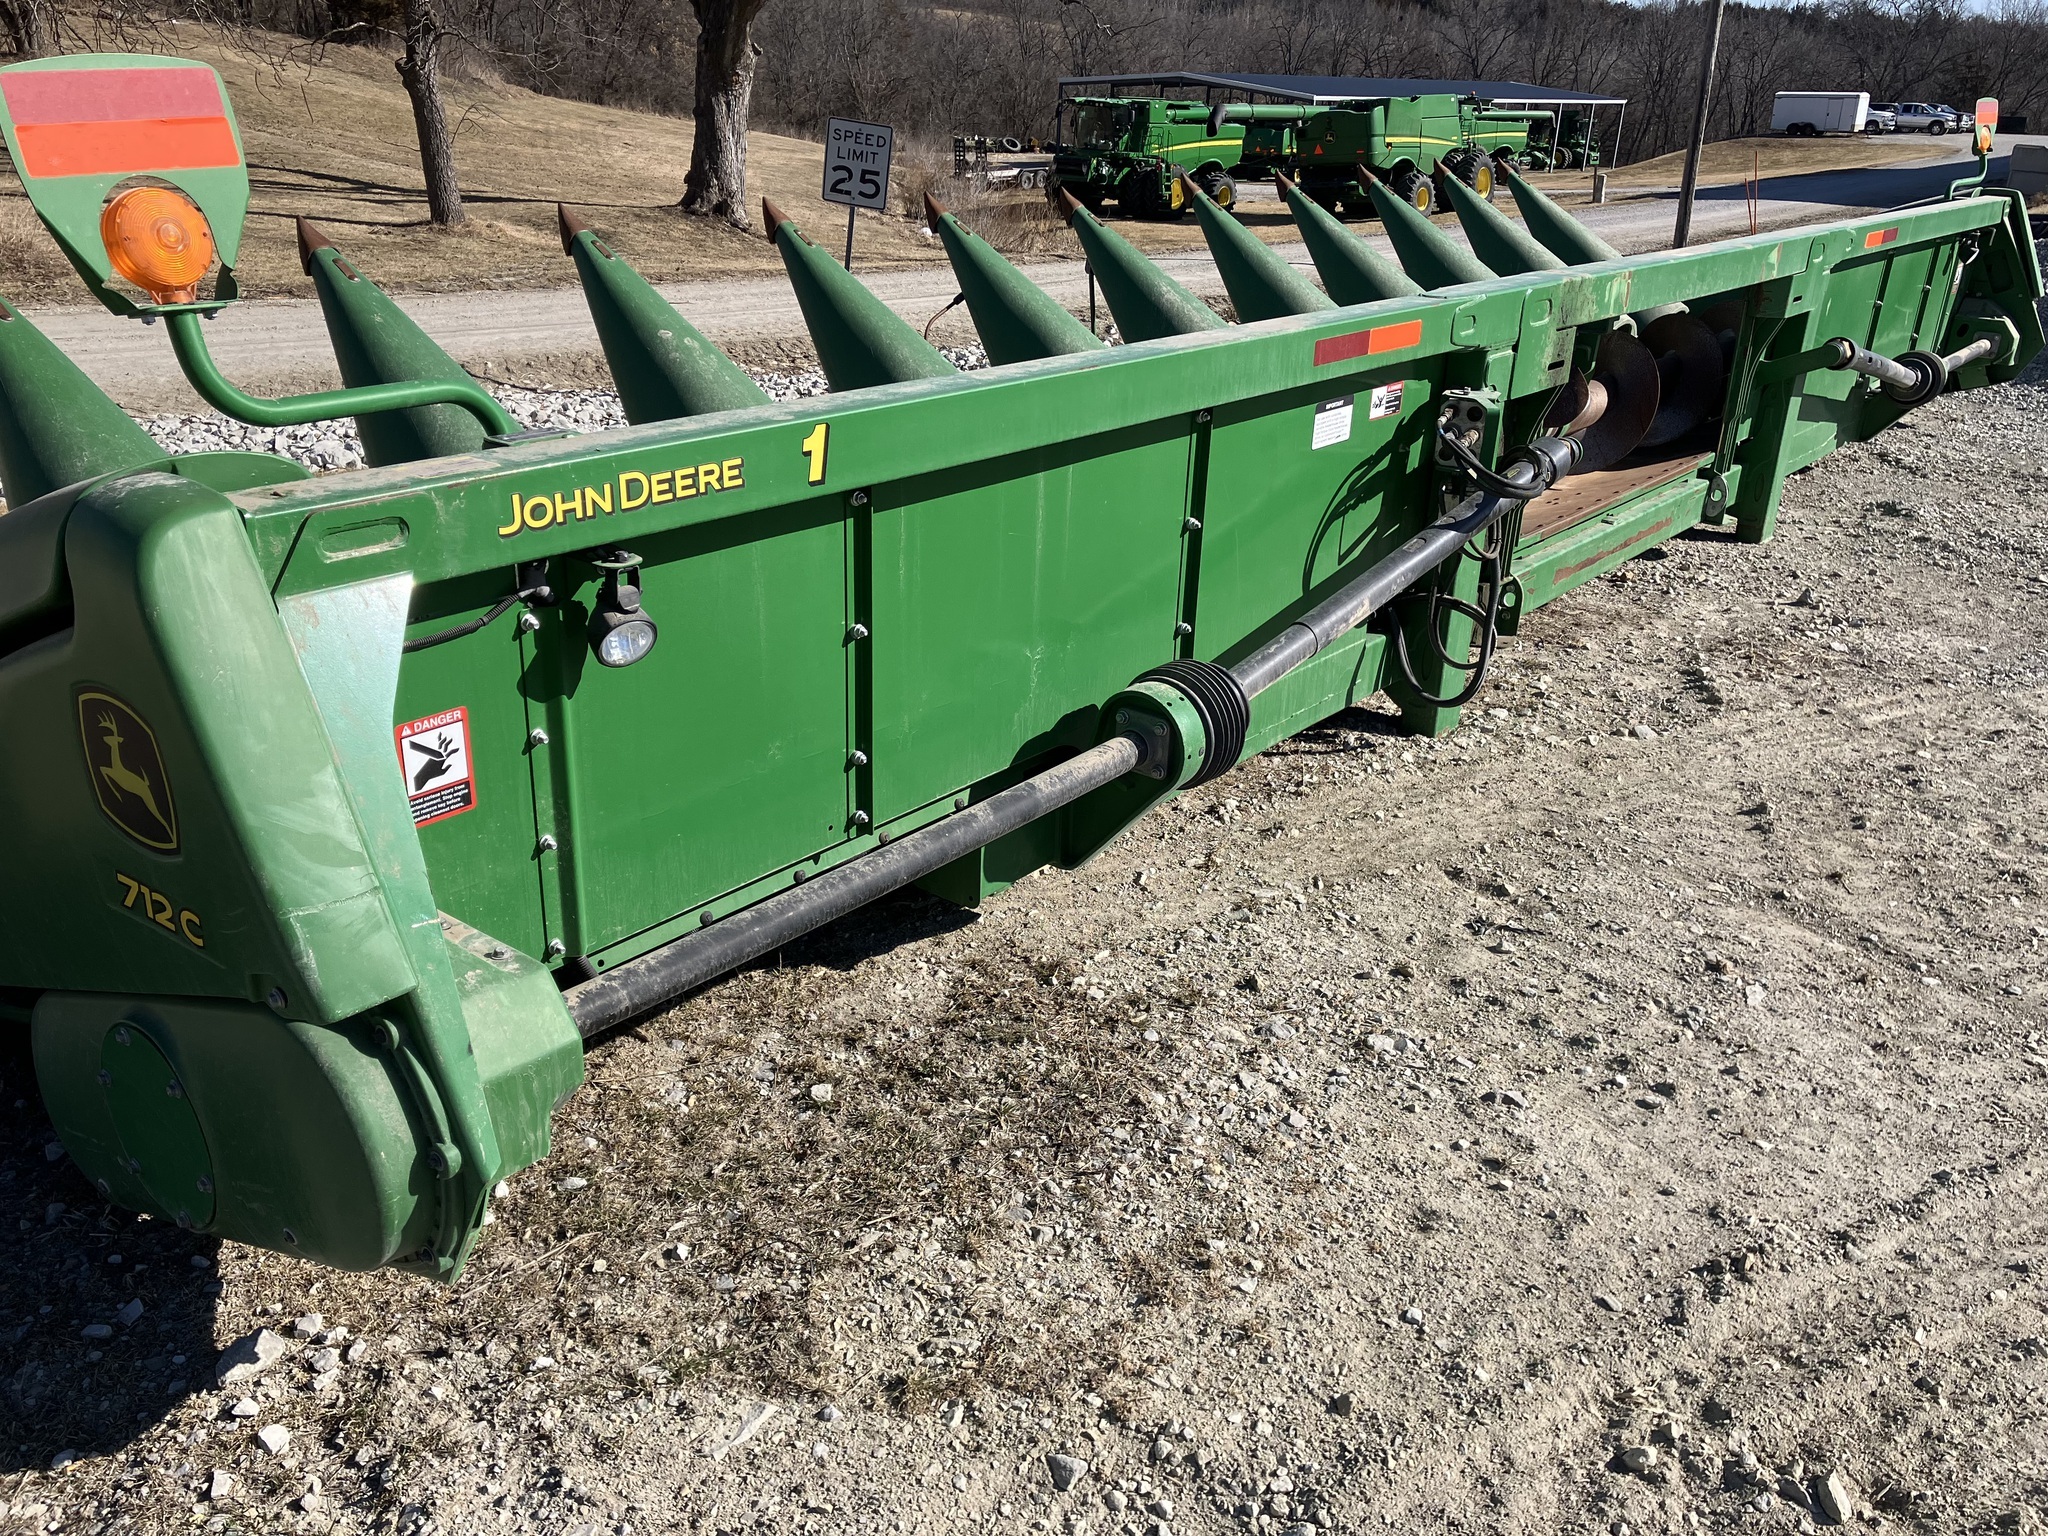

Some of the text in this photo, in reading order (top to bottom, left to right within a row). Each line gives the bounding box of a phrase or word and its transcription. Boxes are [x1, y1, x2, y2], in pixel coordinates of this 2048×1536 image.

[832, 128, 886, 148] SPEED
[837, 146, 879, 165] LIMIT
[830, 165, 881, 199] 25
[801, 422, 830, 487] 1
[497, 457, 745, 538] JOHN DEERE
[413, 710, 462, 731] DANGER
